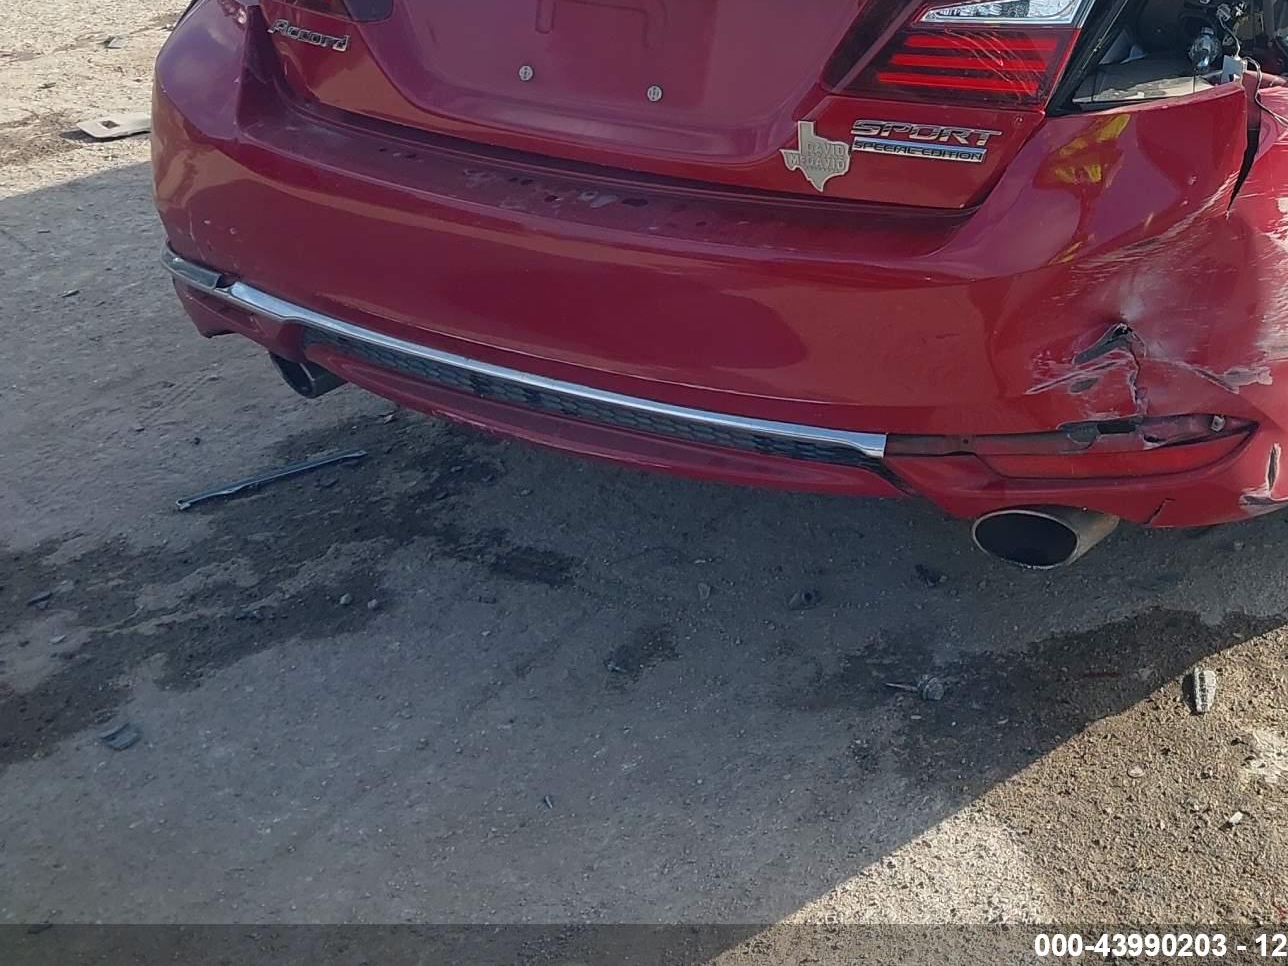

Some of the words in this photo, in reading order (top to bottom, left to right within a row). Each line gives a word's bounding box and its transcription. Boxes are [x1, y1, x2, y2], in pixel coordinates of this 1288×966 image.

[267, 18, 349, 52] Accord
[851, 120, 1002, 146] SPORT
[807, 143, 845, 156] DAVID
[853, 139, 920, 156] SPECIAL
[921, 147, 983, 161] EDITION
